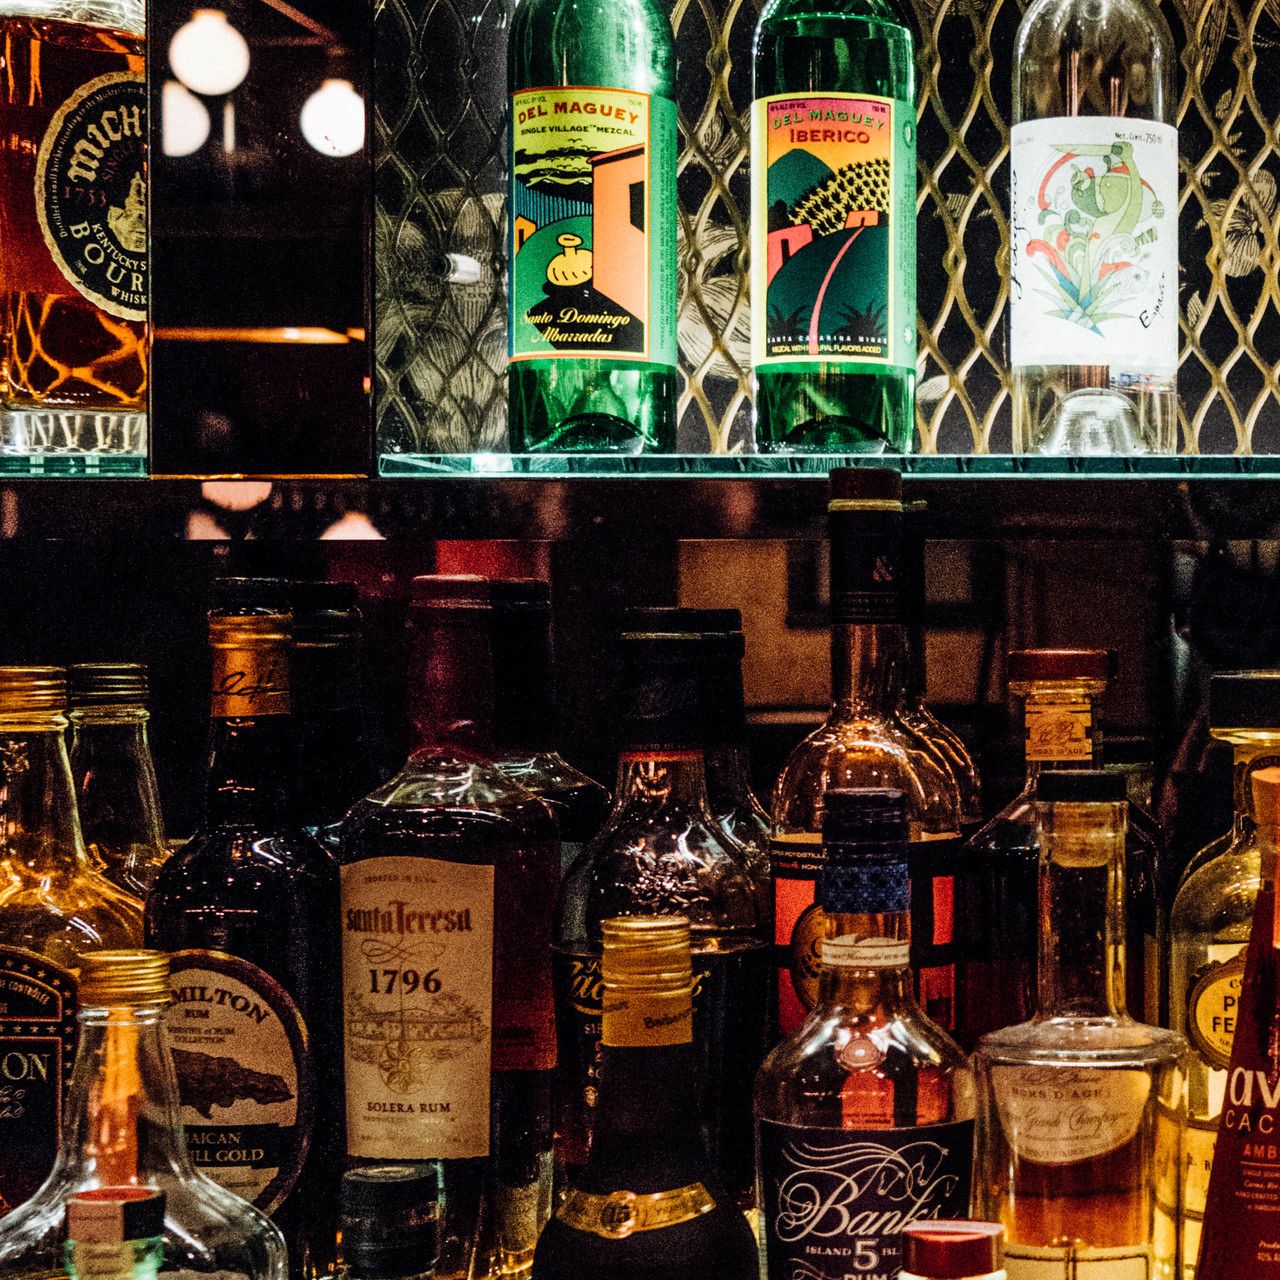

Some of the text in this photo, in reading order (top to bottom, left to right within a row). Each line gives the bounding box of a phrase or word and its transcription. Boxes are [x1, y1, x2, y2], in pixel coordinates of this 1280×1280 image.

[518, 103, 548, 125] DEL
[554, 101, 639, 125] MAGUEY
[772, 109, 885, 130] DEL MAGUEY
[521, 125, 635, 137] SINGLE MEZCAL
[790, 129, 870, 144] IBERICO
[69, 221, 144, 292] BOUR
[111, 285, 147, 305] WHISK
[557, 307, 631, 331] Domingo
[531, 326, 614, 343] Albarradas
[799, 335, 851, 343] CAARINA
[370, 969, 442, 994] 1796
[171, 986, 270, 1023] MILTON
[185, 1009, 210, 1019] RUM
[367, 1102, 451, 1113] SOLERA RUM
[216, 1149, 264, 1162] GOLD
[806, 1238, 880, 1270] ISLAND 5
